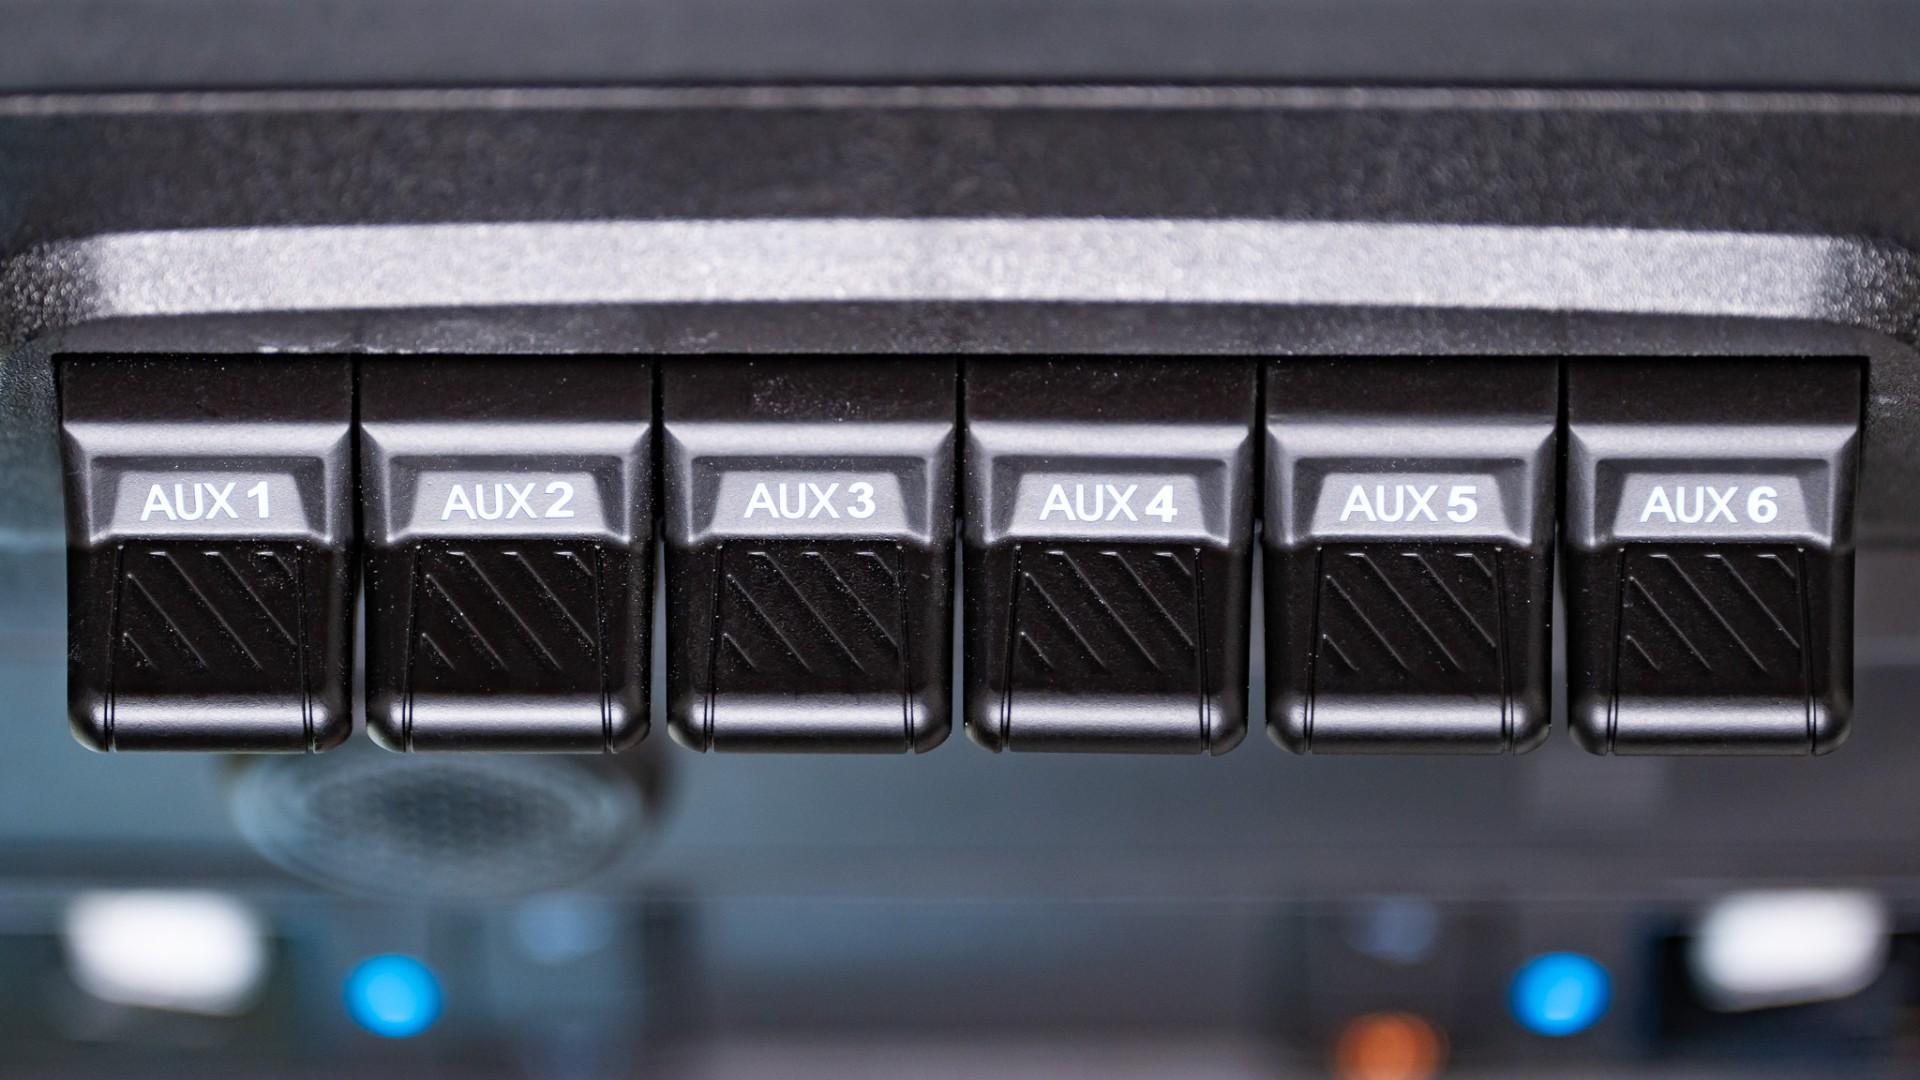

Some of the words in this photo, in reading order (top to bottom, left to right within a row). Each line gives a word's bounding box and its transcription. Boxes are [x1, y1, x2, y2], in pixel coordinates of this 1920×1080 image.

[140, 482, 239, 522] AUX
[247, 481, 271, 519] 1
[440, 482, 539, 521] AUX
[545, 480, 575, 519] 2
[743, 482, 841, 520] AUX
[847, 482, 876, 520] 3
[1039, 484, 1139, 522] AUX
[1145, 484, 1178, 523] 4
[1339, 485, 1439, 523] AUX
[1446, 485, 1478, 523] 5
[1639, 485, 1739, 523] AUX
[1746, 485, 1779, 524] 6
